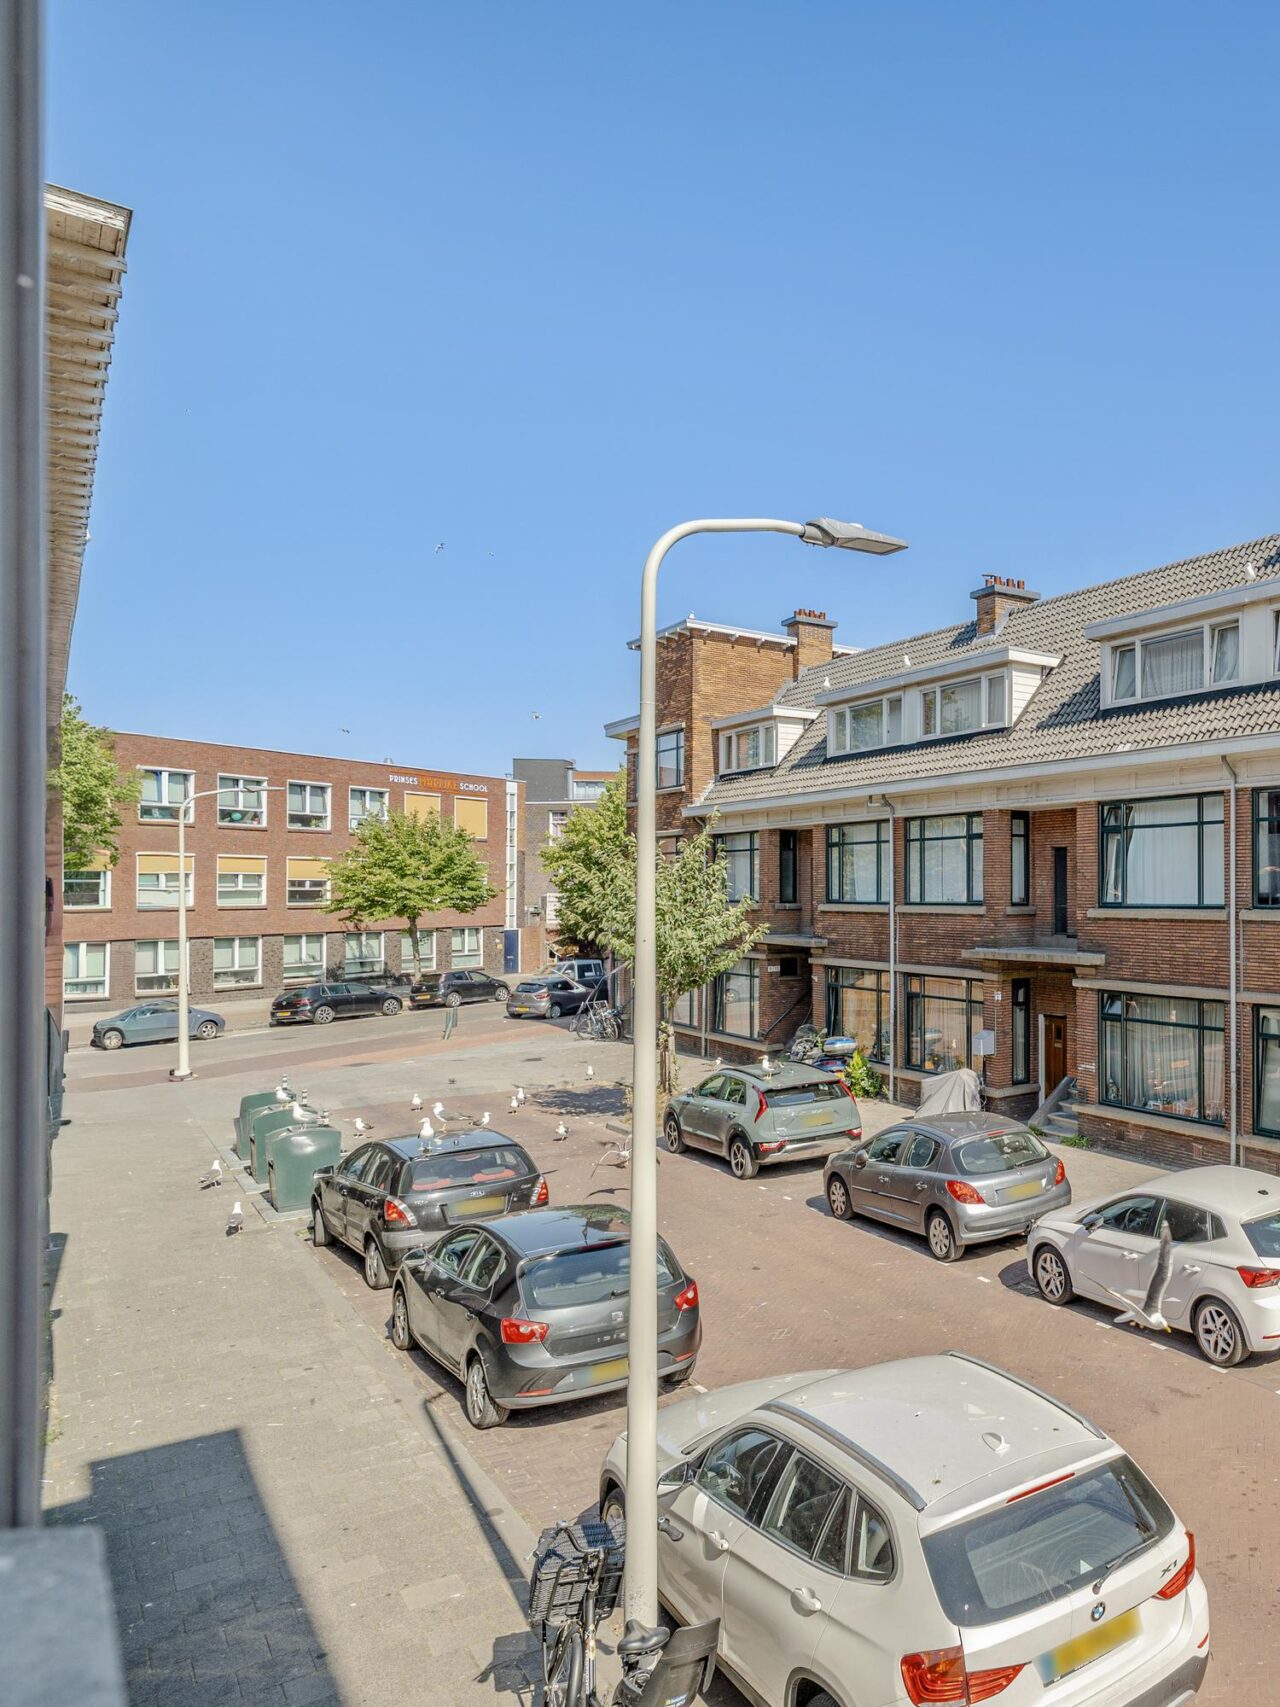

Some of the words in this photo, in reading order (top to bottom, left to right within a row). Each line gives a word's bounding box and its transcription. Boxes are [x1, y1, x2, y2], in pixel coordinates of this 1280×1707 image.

[389, 774, 418, 785] PRINSES
[459, 782, 488, 793] SCHOOL
[1160, 1559, 1178, 1579] X1
